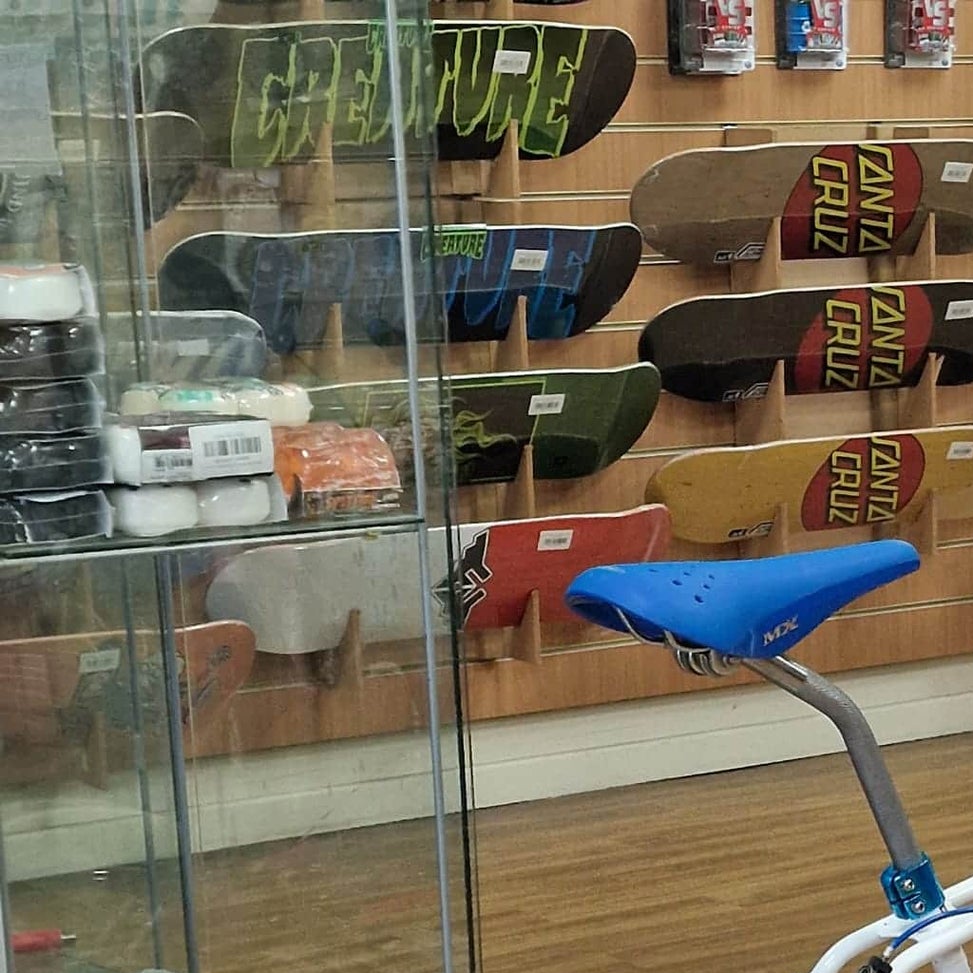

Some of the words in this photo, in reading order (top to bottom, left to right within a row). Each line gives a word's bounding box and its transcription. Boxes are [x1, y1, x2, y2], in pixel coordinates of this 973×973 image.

[812, 155, 849, 254] CRUZ
[858, 143, 895, 253] SANTA
[825, 299, 862, 389] CRUZ
[869, 285, 906, 388] SANTA
[828, 450, 862, 524] CRUZ
[866, 436, 901, 523] SANTA
[763, 614, 799, 647] MX
